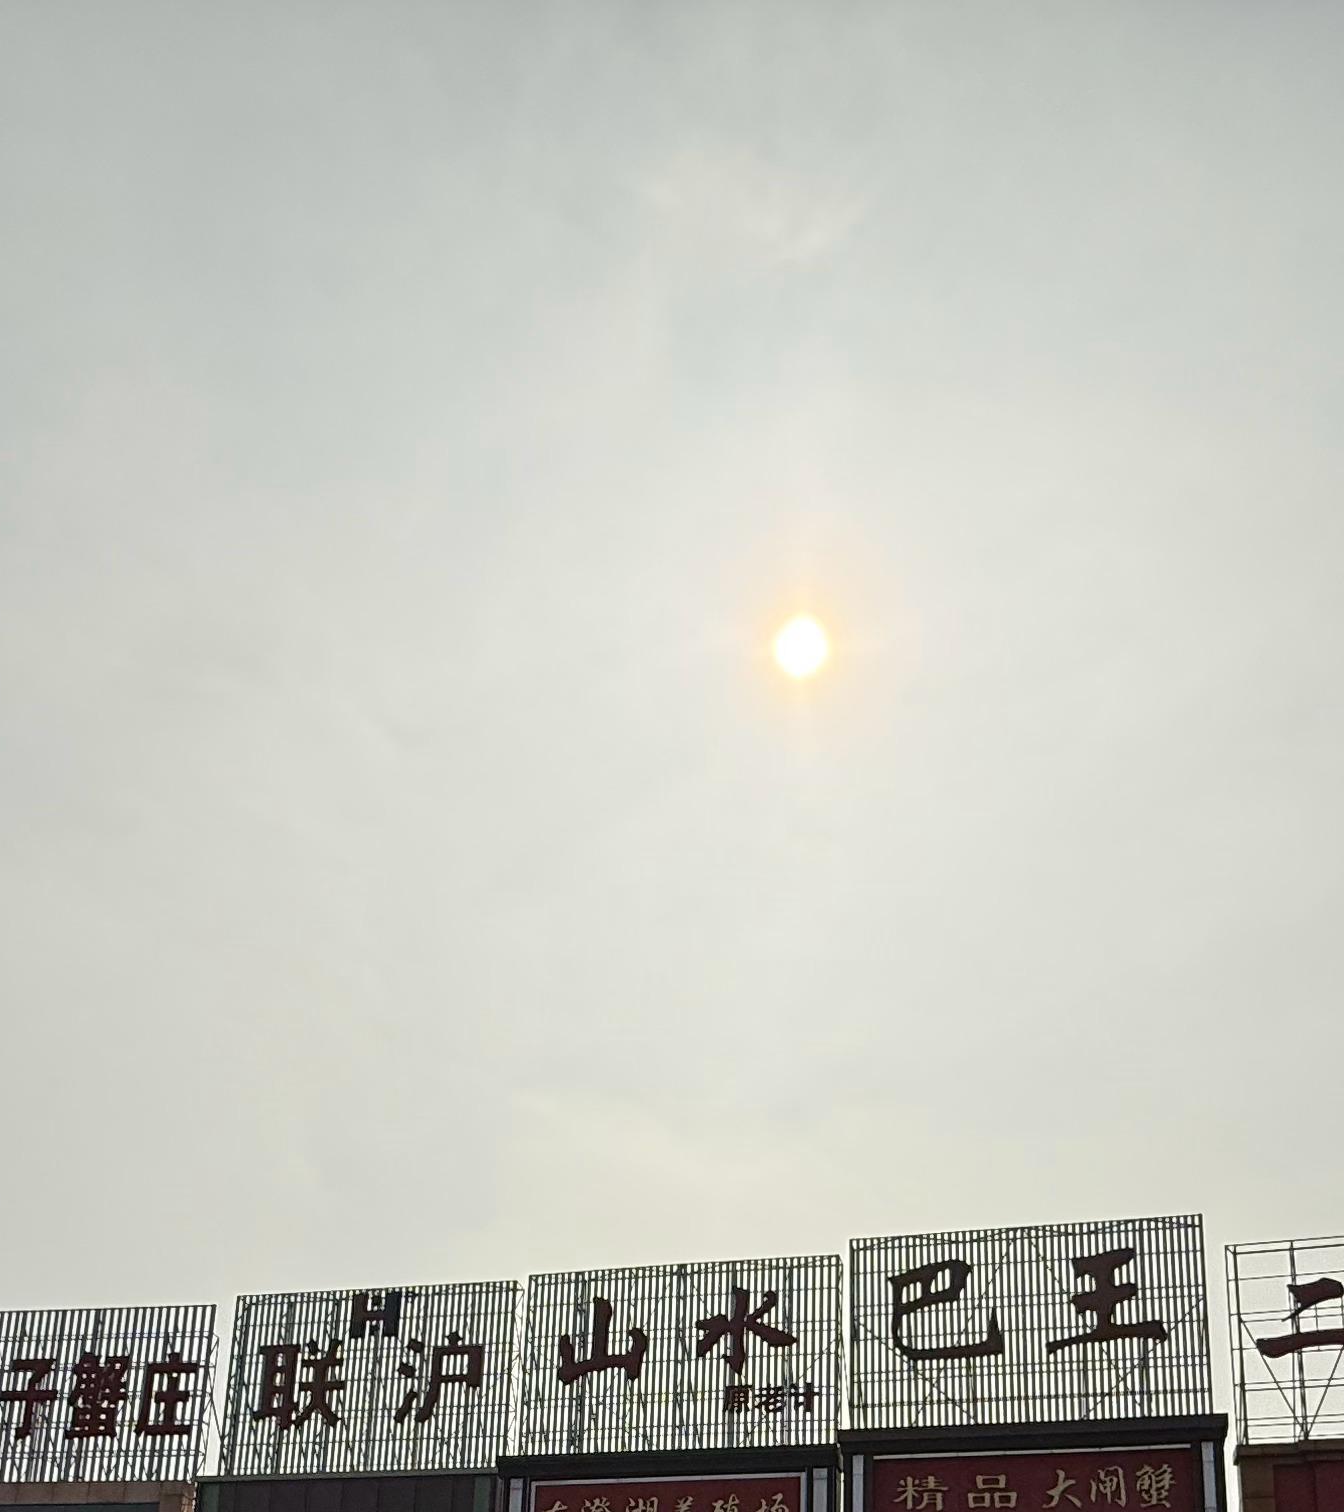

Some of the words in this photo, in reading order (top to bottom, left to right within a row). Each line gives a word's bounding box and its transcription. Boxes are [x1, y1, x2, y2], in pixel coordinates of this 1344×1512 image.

[557, 1286, 799, 1385] 山水
[888, 1247, 1168, 1362] 巴王
[253, 1333, 484, 1430] 联沪
[893, 1462, 1177, 1512] 精品大闸蟹
